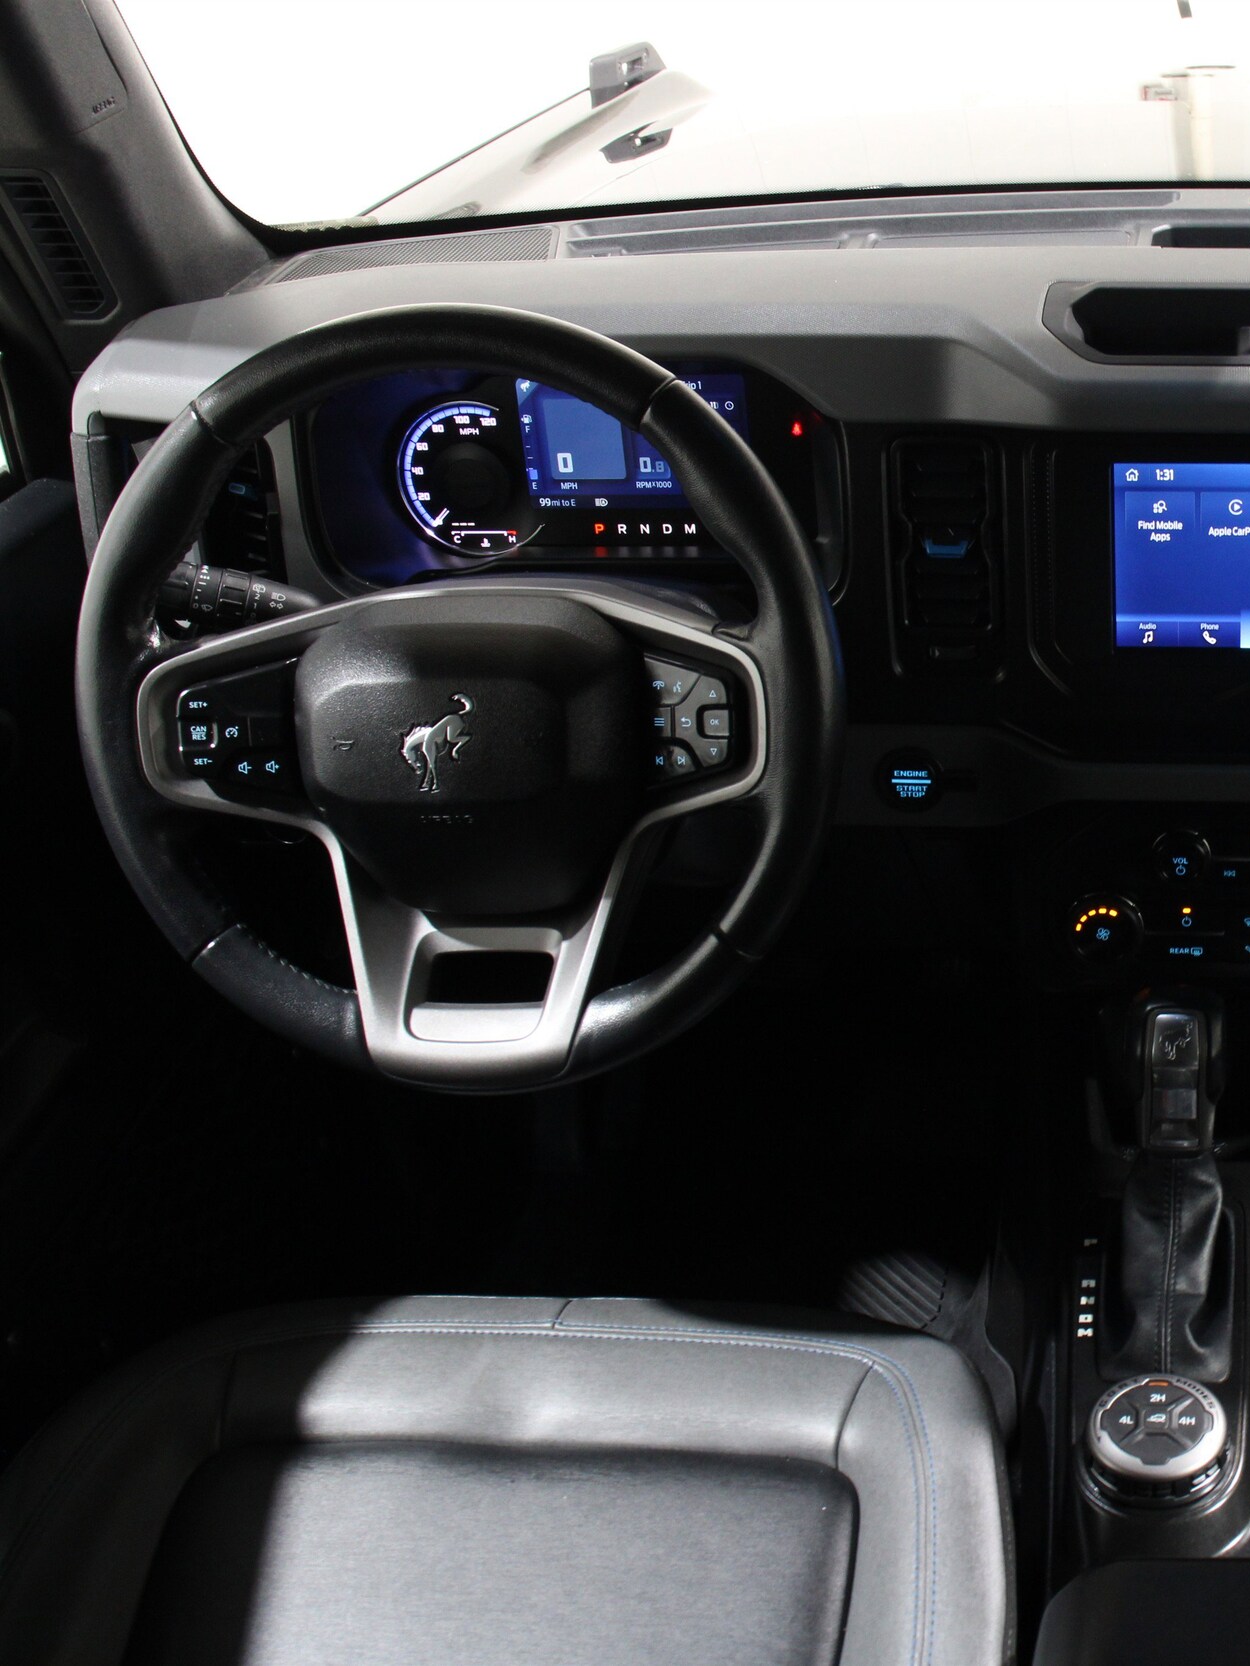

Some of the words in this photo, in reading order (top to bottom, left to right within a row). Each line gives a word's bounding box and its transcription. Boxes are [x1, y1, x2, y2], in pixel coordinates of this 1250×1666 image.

[453, 415, 470, 424] 100
[479, 417, 497, 427] 120
[431, 424, 445, 433] 80
[459, 427, 480, 436] MPH
[525, 425, 530, 434] F
[415, 442, 429, 451] 60
[556, 452, 574, 473] 0
[411, 466, 424, 476] 40
[1155, 469, 1174, 481] 1:31
[532, 481, 538, 490] E
[560, 482, 578, 490] MPH
[417, 492, 431, 501] 20
[561, 499, 570, 507] to
[570, 499, 577, 507] E
[594, 523, 605, 535] P
[617, 523, 627, 535] R
[639, 523, 651, 535] N
[662, 523, 673, 535] D
[683, 523, 697, 535] M
[1137, 520, 1154, 531] Find
[1155, 520, 1183, 531] Mobile
[1208, 526, 1232, 538] Apple
[453, 535, 462, 544] C
[508, 535, 517, 544] H
[1150, 532, 1171, 543] Apps
[1138, 622, 1157, 630] Audio
[1200, 622, 1219, 631] Phone
[709, 718, 720, 727] OK
[893, 770, 928, 778] ENGINE
[1172, 857, 1188, 865] VOL
[1077, 1328, 1094, 1337] M
[1149, 1393, 1166, 1403] 2H
[1118, 1415, 1134, 1425] 4L
[1178, 1416, 1196, 1426] 4H
